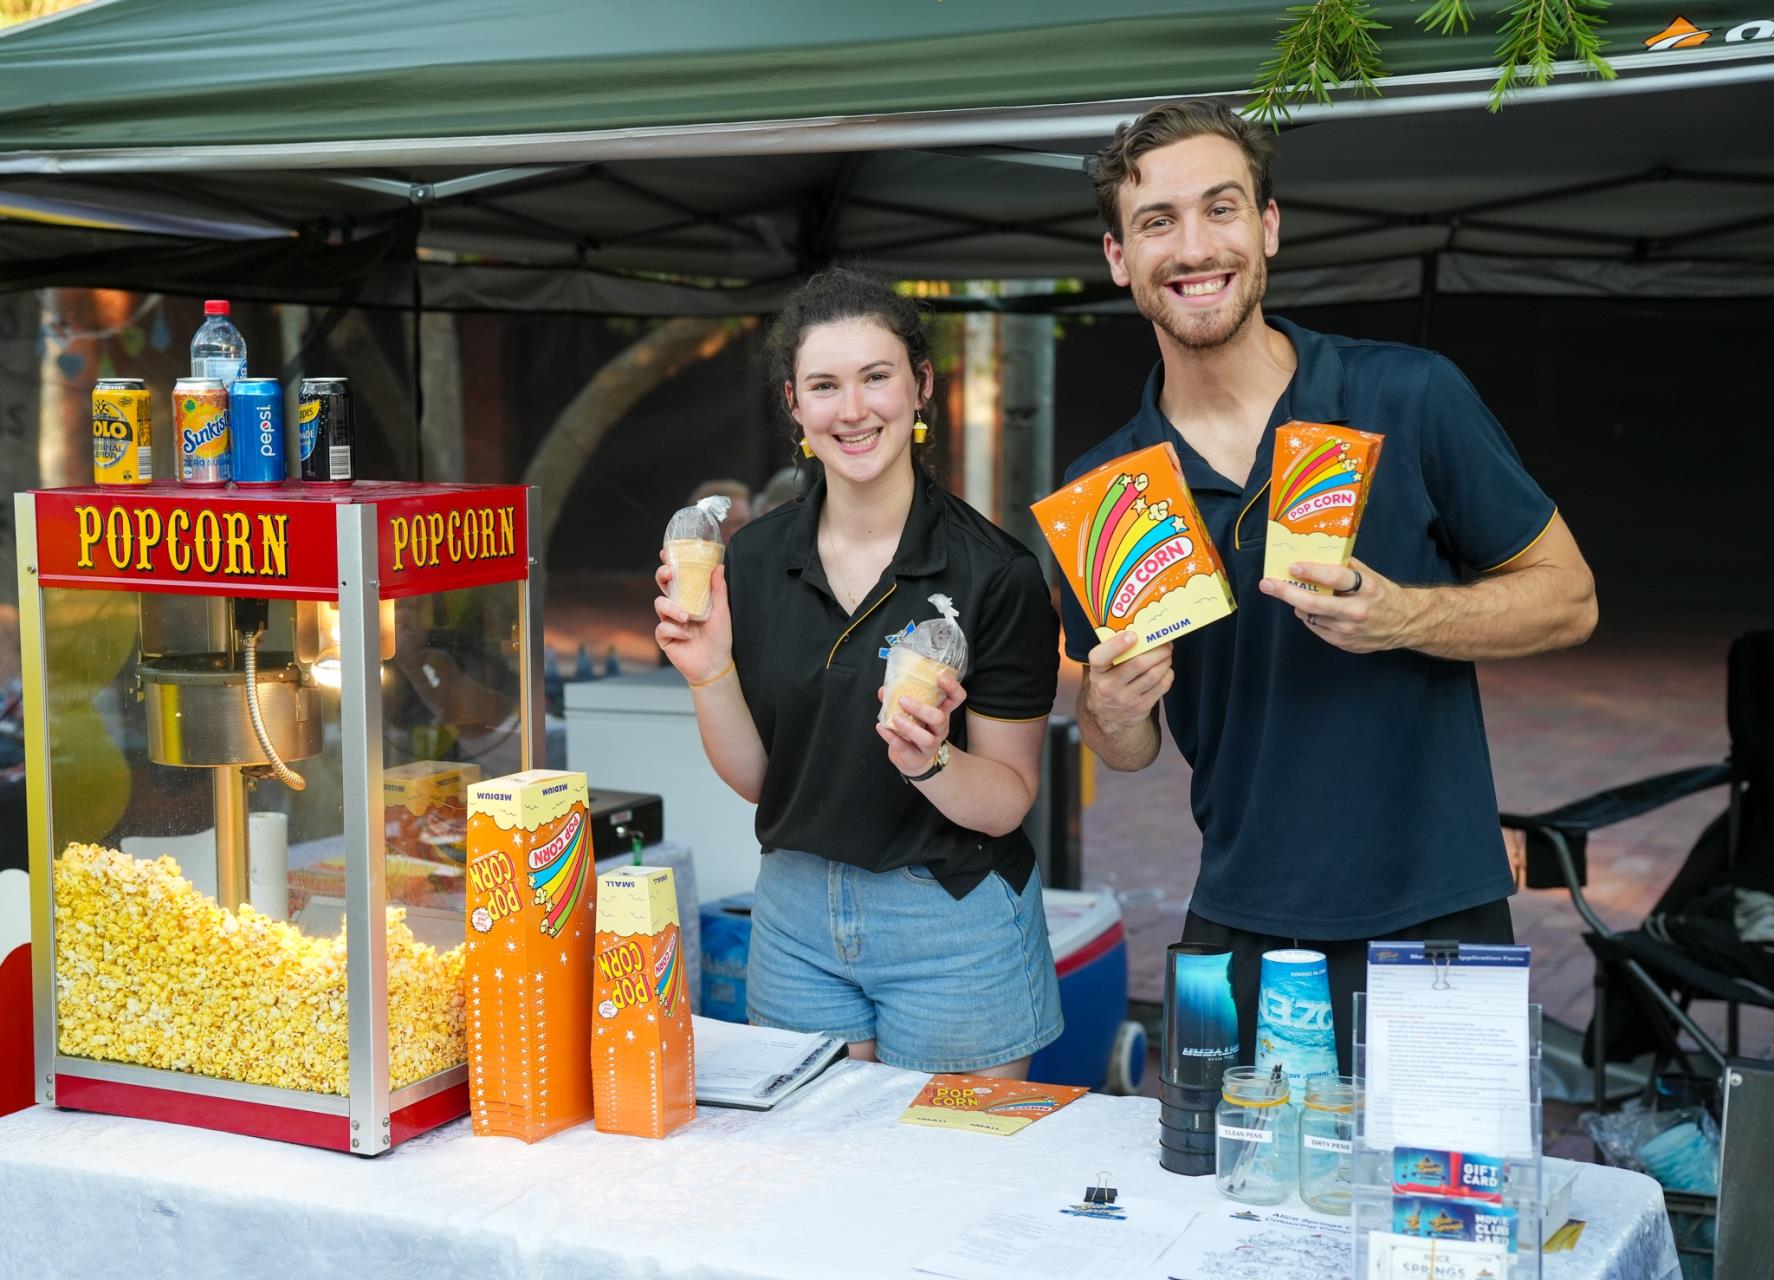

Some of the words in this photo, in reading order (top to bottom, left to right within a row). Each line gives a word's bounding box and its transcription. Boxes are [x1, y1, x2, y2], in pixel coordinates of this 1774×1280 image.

[93, 420, 128, 439] OLO
[256, 405, 276, 456] pepsi
[1290, 503, 1311, 518] POP
[1313, 493, 1352, 508] CORN
[74, 505, 289, 579] POPCORN
[390, 506, 515, 572] POPCORN
[1114, 583, 1136, 613] POP
[1135, 541, 1185, 583] CORN
[1283, 579, 1319, 593] MALL
[1146, 617, 1191, 643] MEDIUM
[477, 792, 512, 801] MEDIUM
[542, 783, 568, 796] MEDIUM
[565, 816, 579, 840] POP
[534, 837, 564, 866] CORN
[469, 851, 514, 895] CORN
[605, 880, 636, 888] SMALL
[487, 882, 522, 921] POP
[598, 941, 646, 982] CORN
[612, 974, 652, 1009] POP
[936, 1087, 975, 1098] POP
[932, 1098, 980, 1107] CORN
[1224, 1129, 1245, 1137] CLEAN
[1246, 1132, 1263, 1140] PENS
[1311, 1139, 1330, 1148] DIRTY
[1331, 1142, 1350, 1150] PENS
[1463, 1163, 1499, 1178] GIFT
[1463, 1175, 1498, 1187] CARD
[1475, 1213, 1509, 1226] MOVIE
[1475, 1224, 1510, 1237] CLUB
[1402, 1262, 1467, 1279] SPRNGS
